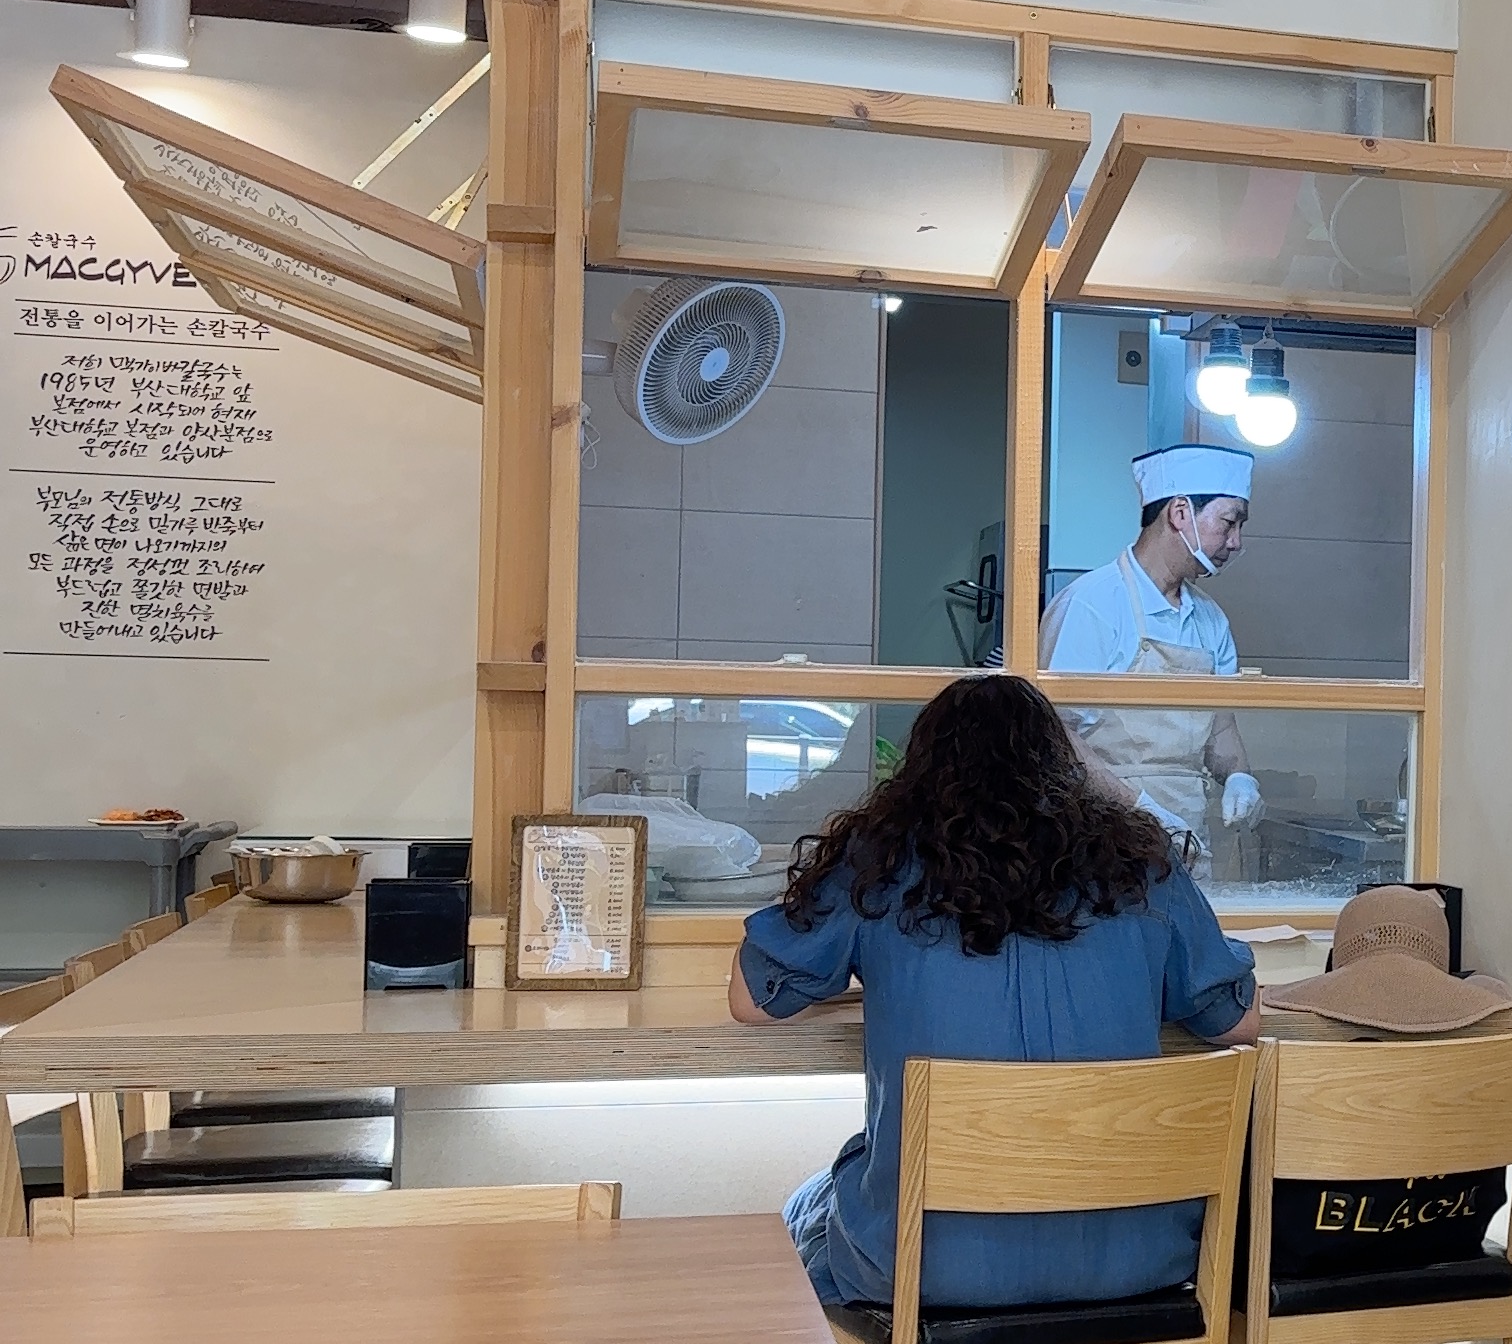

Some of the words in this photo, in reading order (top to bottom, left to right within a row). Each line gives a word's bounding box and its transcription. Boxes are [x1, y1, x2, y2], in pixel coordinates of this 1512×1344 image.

[27, 231, 97, 249] 손칼국수
[24, 254, 197, 287] MACGYVE
[19, 307, 85, 331] 전통을
[93, 311, 178, 335] 이어가는
[187, 318, 271, 341] 손칼국수
[61, 354, 102, 371] 저희
[109, 357, 242, 382] 맥가이버칼국수는
[40, 372, 115, 393] 1985년
[130, 377, 225, 401] 부산대학교
[233, 383, 254, 403] 앞
[52, 394, 121, 414] 본점에서
[129, 401, 205, 419] 시작되어
[211, 403, 256, 422] 현재
[29, 415, 118, 438] 부산대학교
[124, 418, 174, 440] 본점과
[183, 422, 273, 444] 양산분점으로
[79, 438, 148, 458] 운영하고
[160, 440, 233, 464] 있습니다
[36, 486, 91, 512] 부모님의
[100, 490, 180, 514] 전통방식
[190, 497, 242, 512] 그대로
[48, 513, 95, 532] 직접
[101, 514, 140, 534] 손으로
[149, 514, 199, 536] 밀가루
[203, 517, 264, 536] 반죽부터
[52, 530, 89, 552] 삶은
[94, 537, 127, 554] 면이
[136, 538, 227, 554] 나오기까지의
[28, 553, 53, 571] 모든
[61, 557, 114, 576] 과정을
[127, 558, 189, 576] 정성껏
[196, 559, 265, 576] 조리하여
[56, 575, 123, 598] 부드럽고
[131, 579, 185, 600] 쫄깃한
[193, 580, 249, 600] 면발과
[81, 599, 121, 619] 진한
[130, 602, 215, 623] 멸치육수를
[59, 621, 144, 641] 만들어내고
[150, 622, 223, 644] 있습니다
[1315, 1185, 1480, 1233] BLACK
